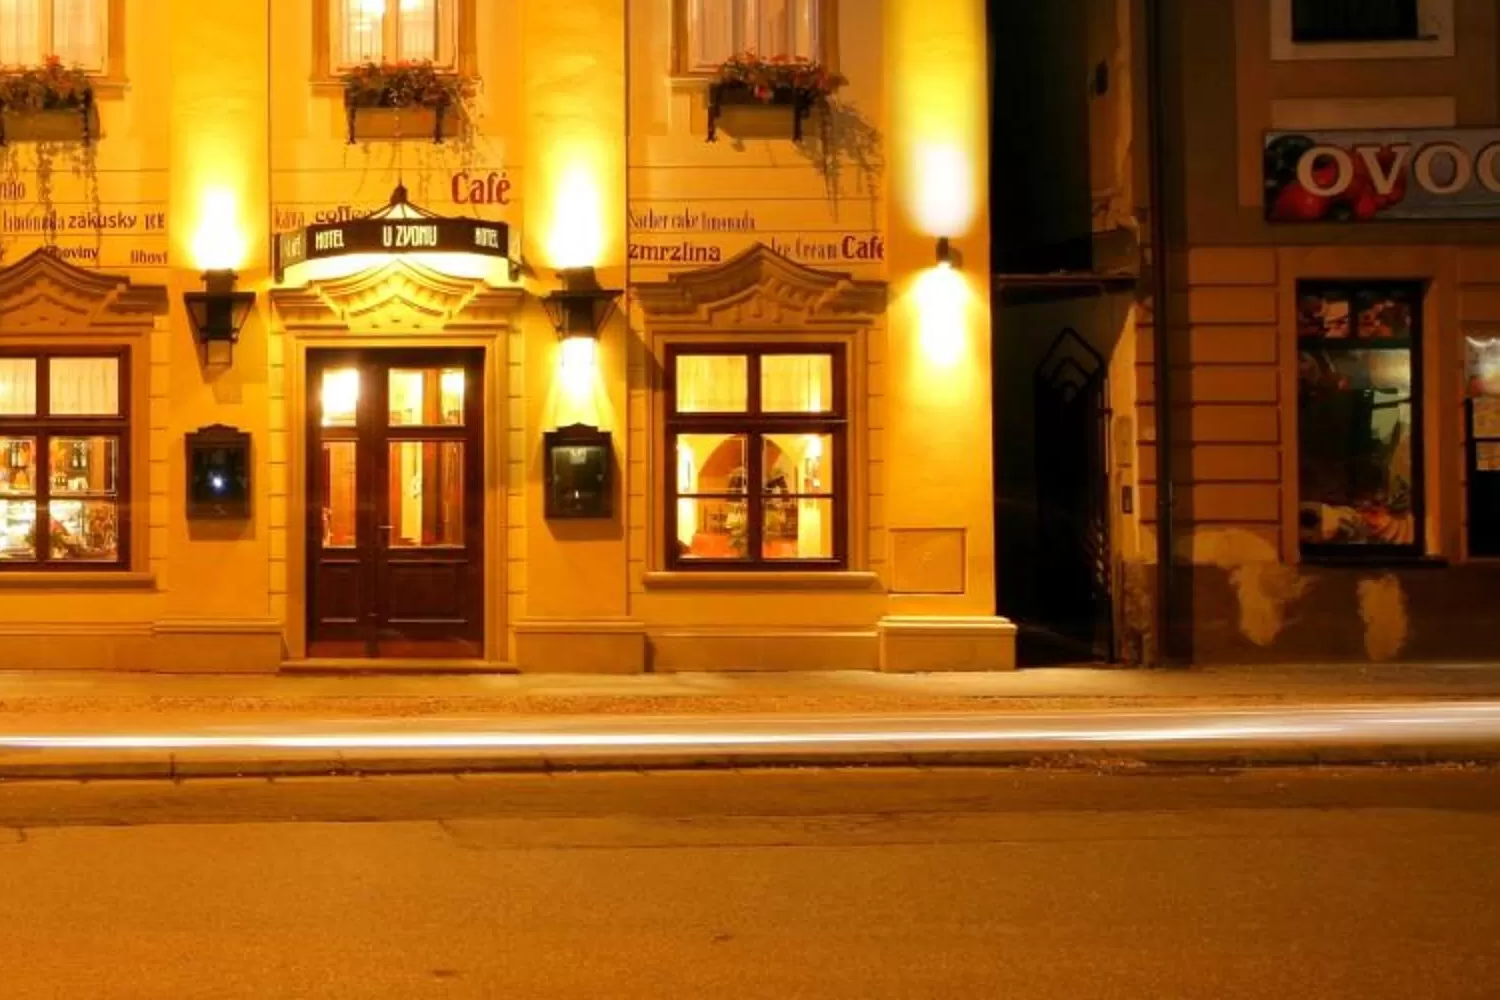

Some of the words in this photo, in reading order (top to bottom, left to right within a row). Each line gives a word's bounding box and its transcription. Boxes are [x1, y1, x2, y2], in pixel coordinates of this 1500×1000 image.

[451, 171, 511, 205] Café
[315, 228, 345, 251] HOTEL
[382, 225, 393, 248] U
[395, 225, 437, 248] ZVONU
[628, 242, 721, 262] zmrzlina
